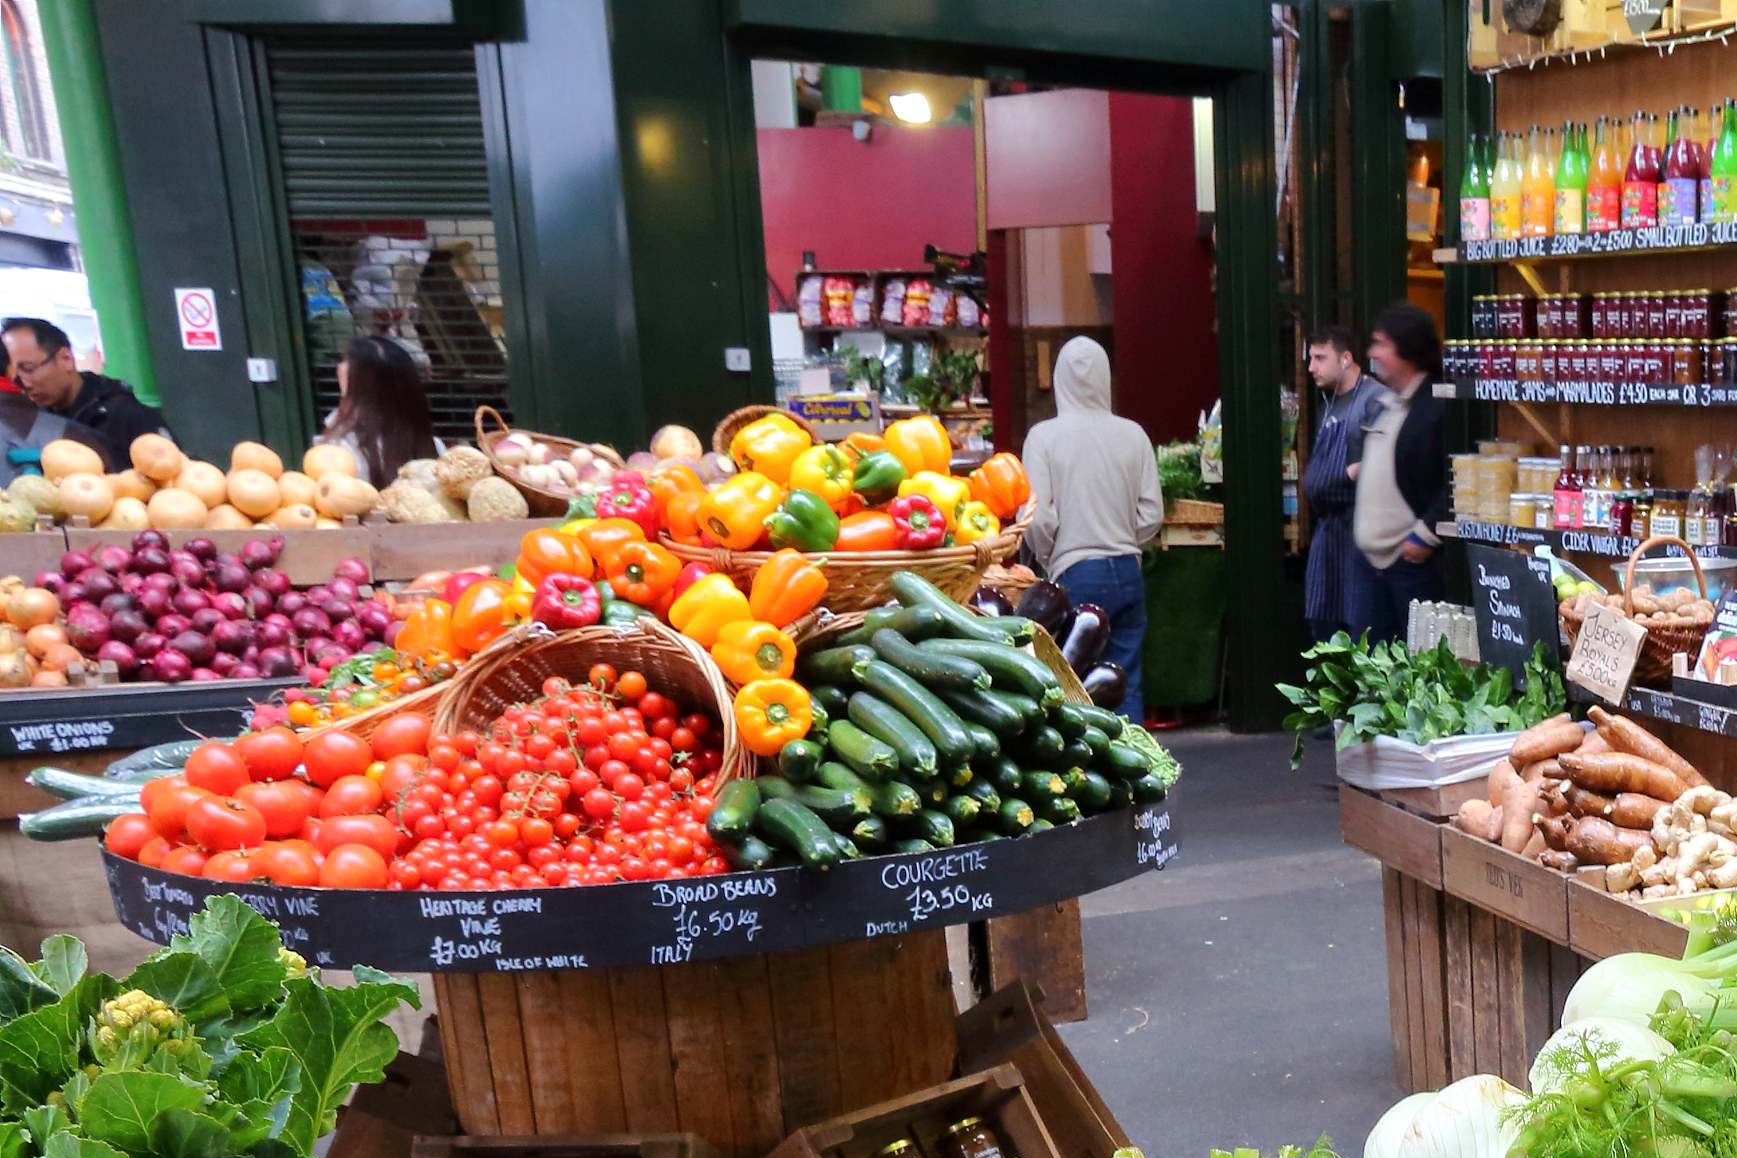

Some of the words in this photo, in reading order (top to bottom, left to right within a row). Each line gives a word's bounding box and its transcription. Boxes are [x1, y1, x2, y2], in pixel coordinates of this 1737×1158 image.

[1483, 239, 1517, 259] BOTTLED
[1519, 237, 1546, 256] JUICE
[1636, 228, 1666, 248] SMALL
[1666, 223, 1707, 247] BOTTLED
[1711, 222, 1737, 244] JUICE
[1475, 379, 1518, 401] HOMEMADE
[1522, 381, 1546, 401] JAMS
[1556, 381, 1614, 404] MARMALADES
[1701, 384, 1711, 407] 3
[1561, 531, 1592, 552] CIDER
[1584, 612, 1628, 651] JERSEY
[11, 724, 56, 742] WHITE
[56, 721, 115, 738] ONIONS
[881, 848, 988, 889] COURGETTE
[652, 883, 719, 907] BROAD
[720, 877, 777, 901] BEANS
[906, 884, 970, 921] £3.50
[972, 893, 993, 911] KG
[284, 896, 319, 916] VINE
[420, 897, 487, 919] HERITAGE
[492, 897, 542, 915] CHERRY
[460, 917, 501, 938] VINE
[866, 921, 908, 937] DUTCH
[495, 957, 523, 971] ISLE
[525, 957, 544, 969] OF
[651, 943, 693, 965] ITALY
